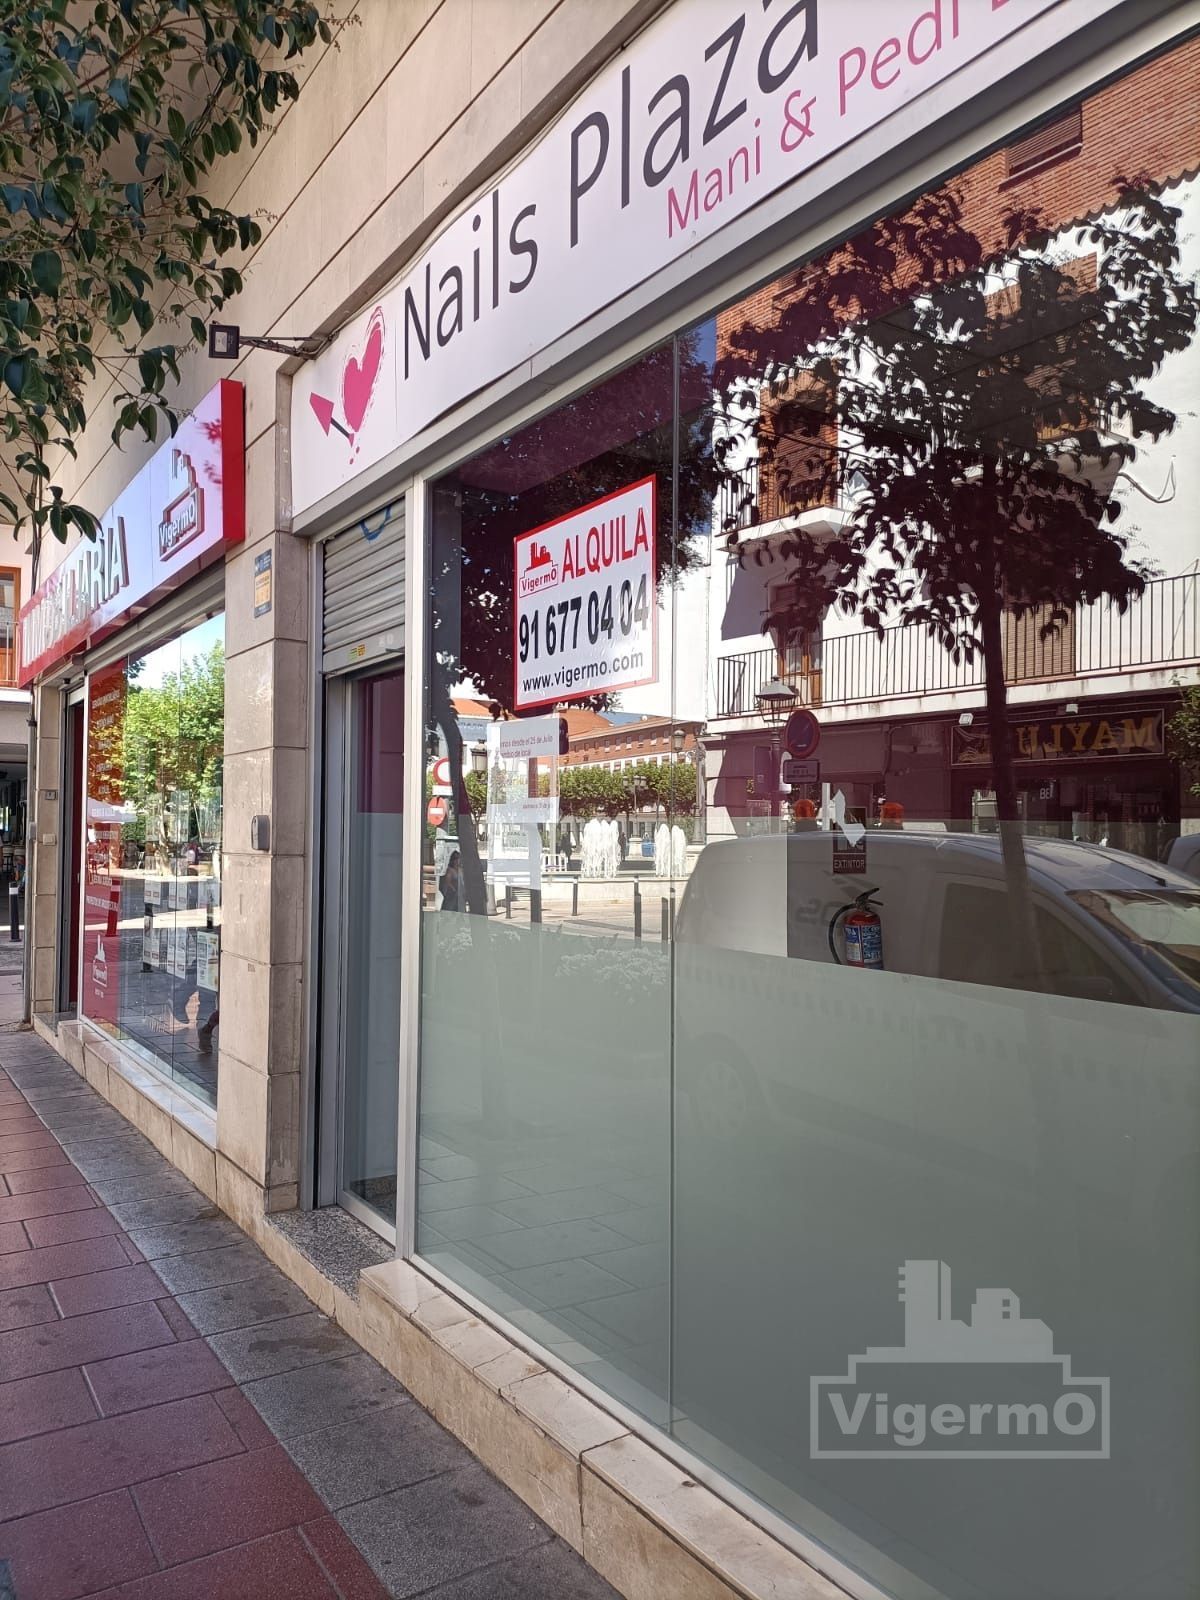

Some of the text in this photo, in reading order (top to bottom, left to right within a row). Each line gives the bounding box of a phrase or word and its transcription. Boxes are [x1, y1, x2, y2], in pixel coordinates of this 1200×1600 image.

[667, 0, 960, 239] Mani & Pedi
[404, 0, 818, 380] Nails Plaza
[562, 507, 649, 583] ALQUILA
[519, 573, 648, 663] 91 677 04 04
[523, 652, 644, 692] www.vigermo.com
[834, 859, 864, 869] EXTINTOR
